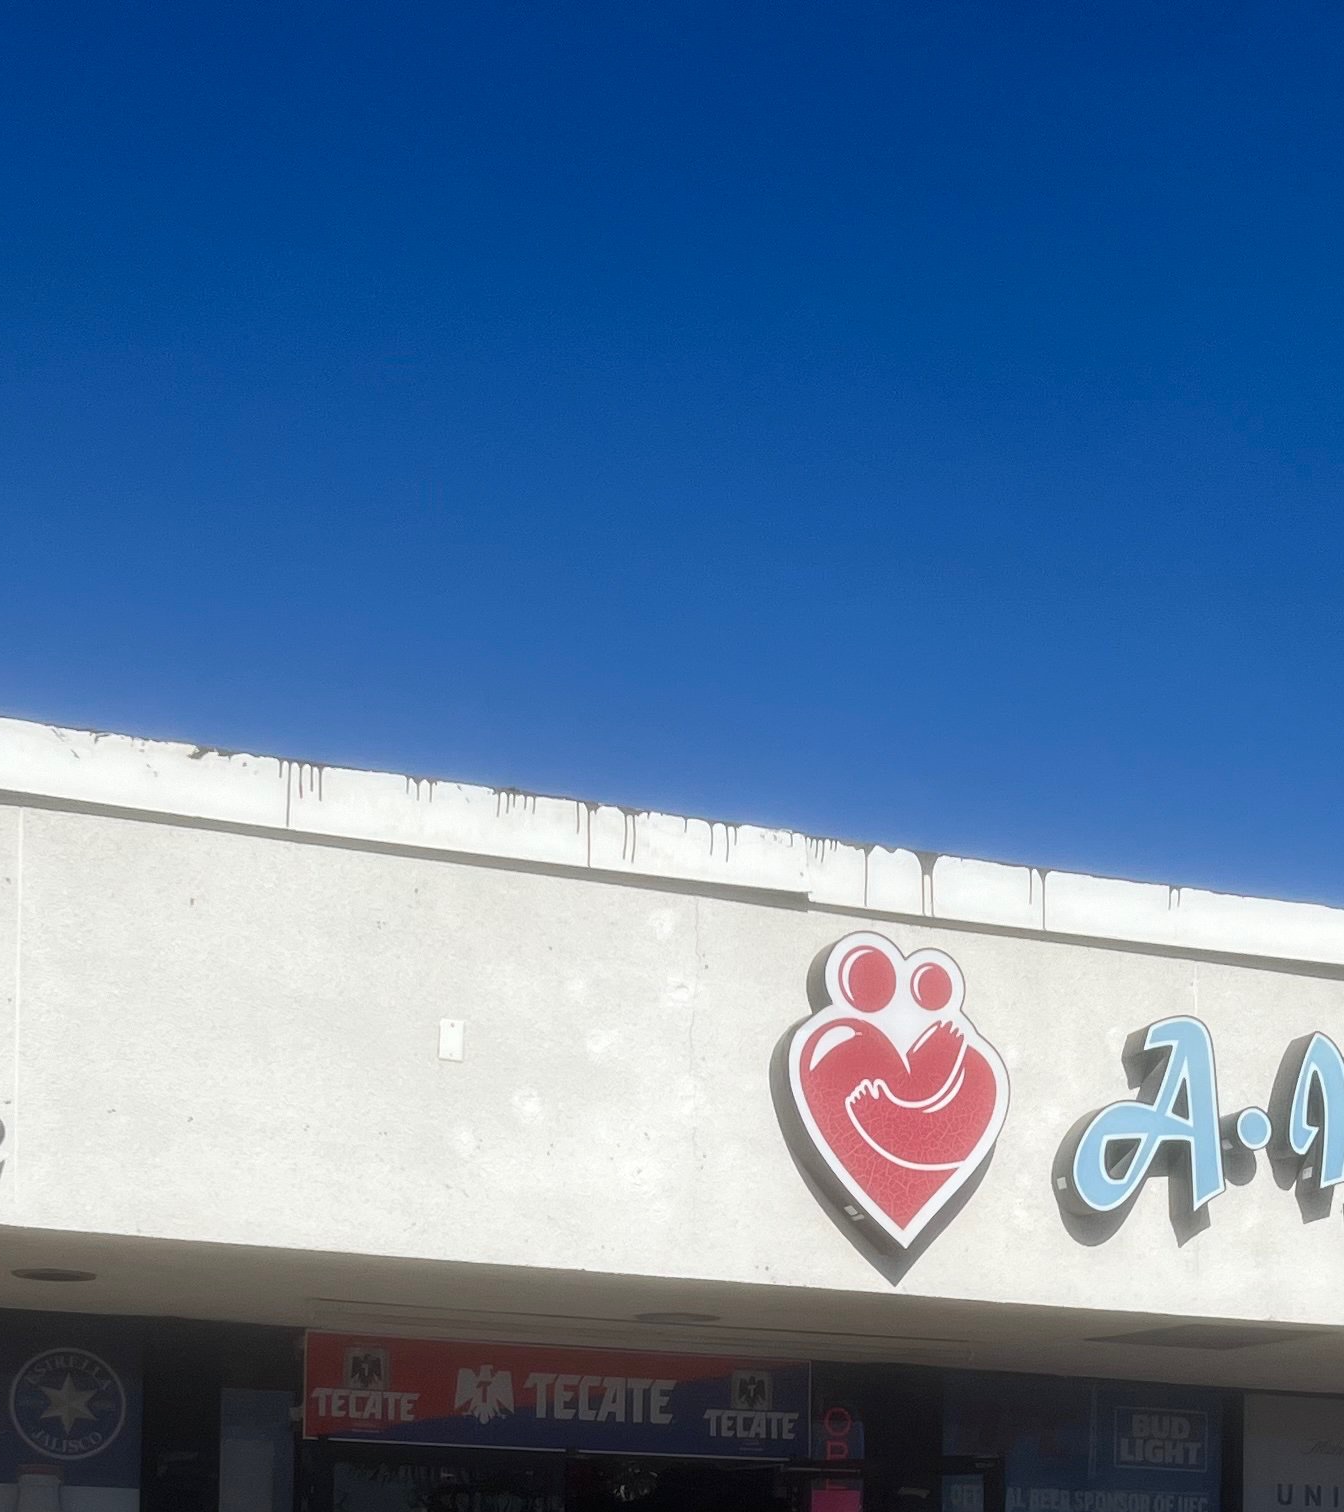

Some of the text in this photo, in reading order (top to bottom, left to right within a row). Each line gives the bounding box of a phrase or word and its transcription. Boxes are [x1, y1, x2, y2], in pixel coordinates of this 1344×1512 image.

[310, 1388, 421, 1422] TECATE
[524, 1372, 677, 1425] TECATE
[703, 1408, 799, 1441] TECATE
[1132, 1414, 1191, 1439] BUD
[32, 1429, 103, 1452] JALISCO
[1120, 1438, 1201, 1465] LIGHT
[1029, 1488, 1071, 1512] BEER
